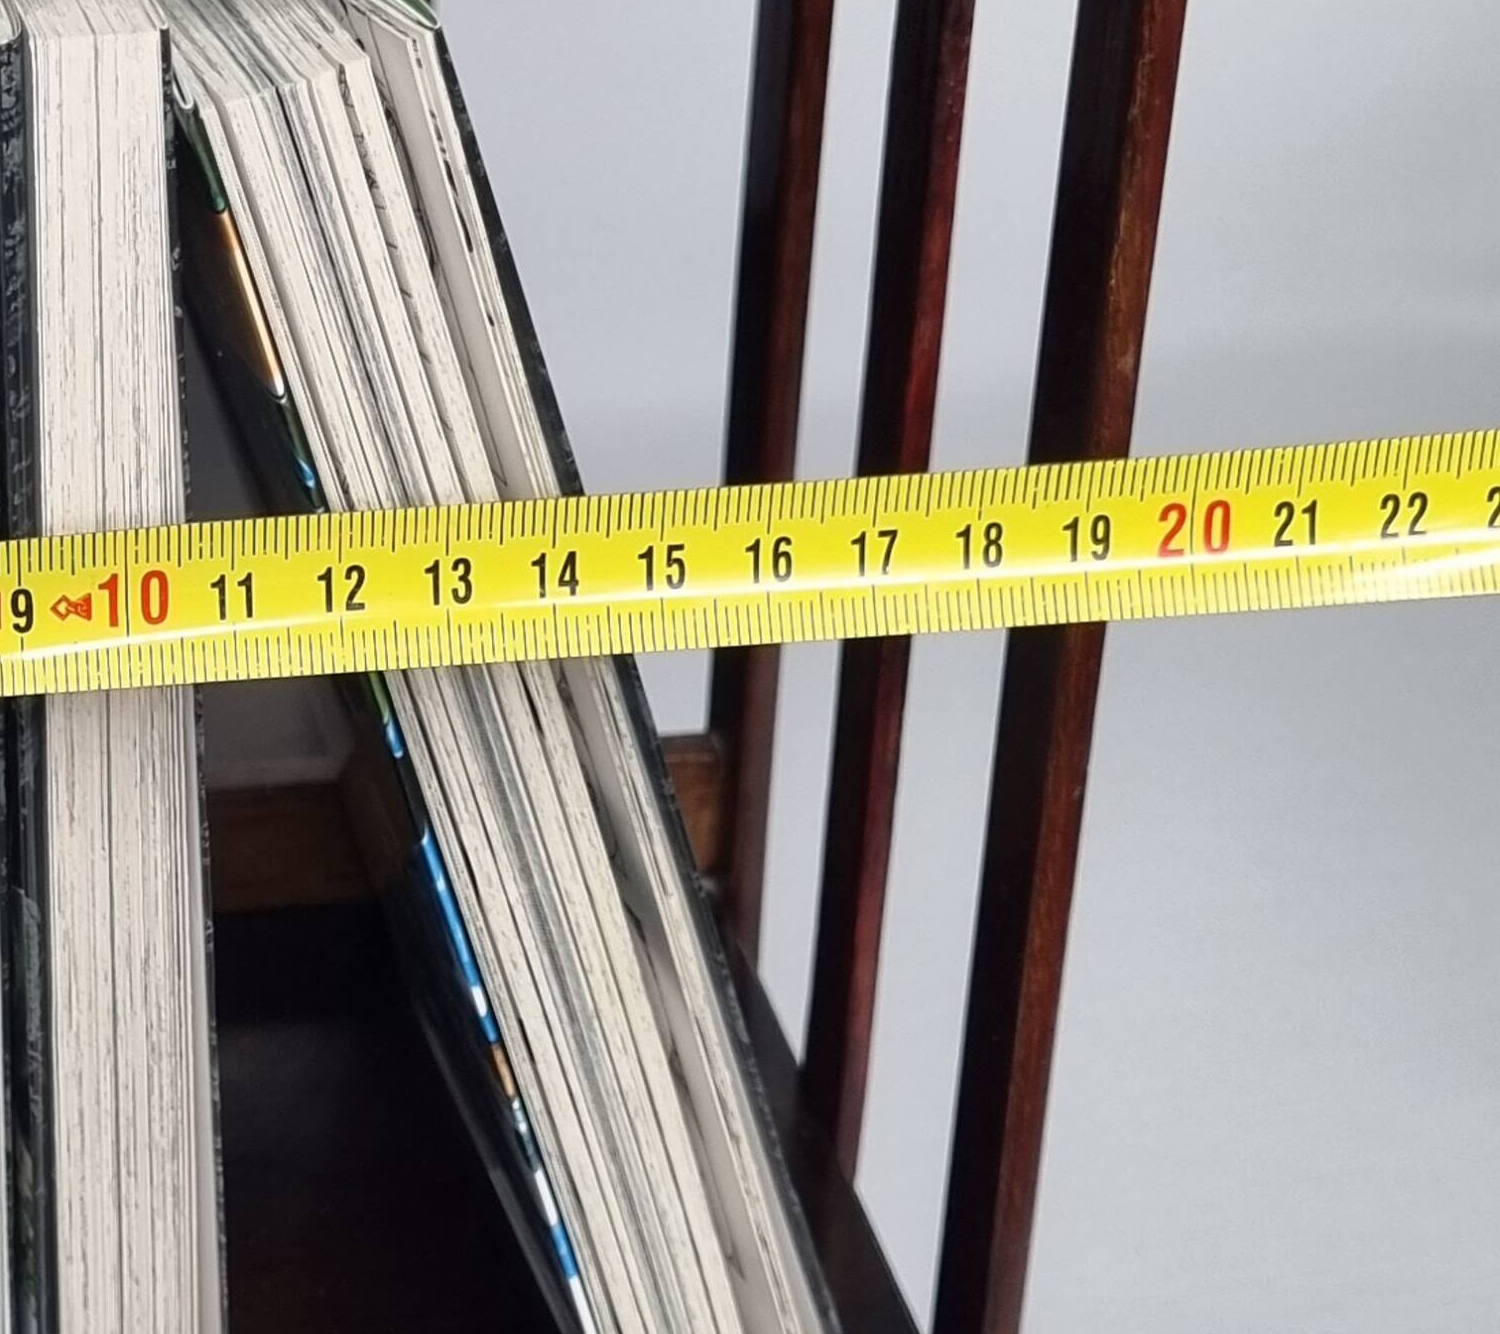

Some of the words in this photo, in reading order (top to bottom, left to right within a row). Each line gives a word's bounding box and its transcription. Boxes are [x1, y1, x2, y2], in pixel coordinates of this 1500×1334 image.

[10, 588, 35, 634] 9
[98, 569, 170, 628] 10
[210, 571, 253, 620] 11
[317, 564, 366, 613] 12
[424, 557, 474, 605] 13
[531, 550, 579, 599] 14
[637, 543, 686, 592] 15
[745, 535, 793, 584] 16
[851, 529, 899, 577] 17
[955, 522, 1004, 569] 18
[1062, 514, 1111, 563] 19
[1157, 499, 1232, 558] 20
[1273, 499, 1318, 547] 21
[1380, 491, 1429, 539] 22
